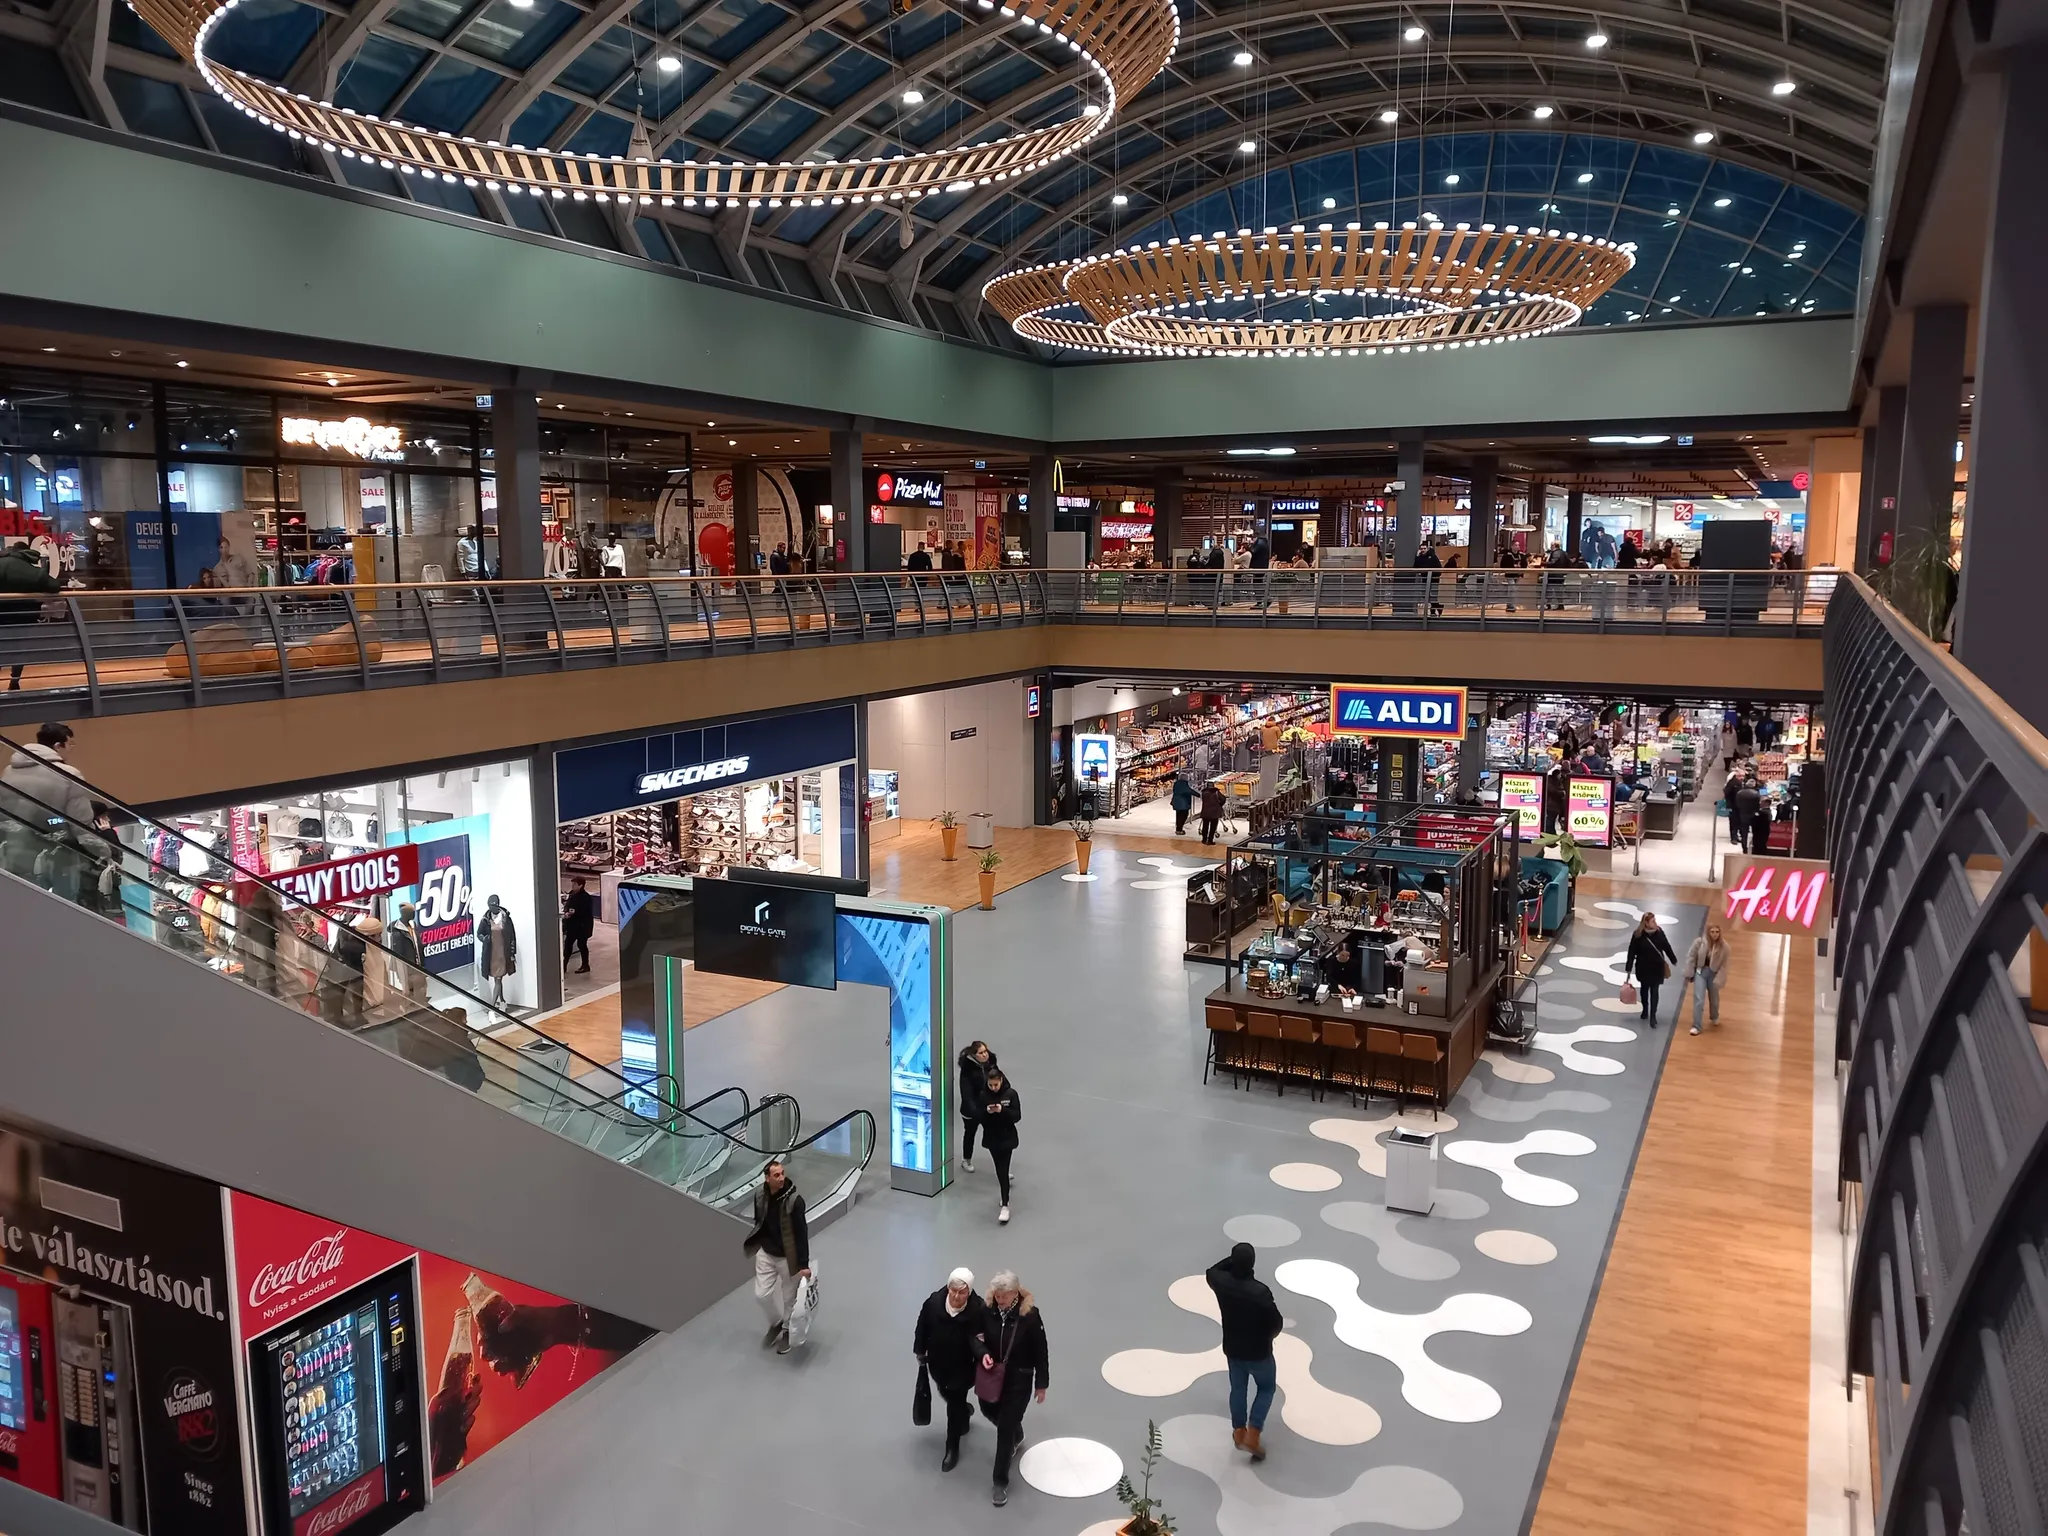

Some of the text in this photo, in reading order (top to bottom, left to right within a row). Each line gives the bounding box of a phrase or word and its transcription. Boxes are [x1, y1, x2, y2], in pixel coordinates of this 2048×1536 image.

[362, 488, 384, 496] SALE
[480, 490, 496, 498] SAL
[894, 477, 941, 499] Pizza Hut
[1377, 700, 1452, 725] ALDI
[638, 756, 750, 794] SKECHERS
[1574, 816, 1605, 825] 60 %
[435, 855, 452, 868] AKÁR
[271, 867, 334, 911] EAVY
[336, 854, 400, 898] TOOLS
[416, 865, 474, 927] -50%
[1726, 866, 1827, 929] H&M
[420, 919, 473, 945] EDVEZMÉNY
[450, 933, 474, 949] EREJÉIG
[740, 924, 766, 934] DIGITAL
[767, 928, 786, 937] GATE
[30, 1226, 225, 1321] választásod.
[249, 1227, 349, 1308] Coca-Cola
[263, 1301, 289, 1320] Nyiss
[298, 1276, 338, 1302] csodára!
[184, 1472, 214, 1494] Since
